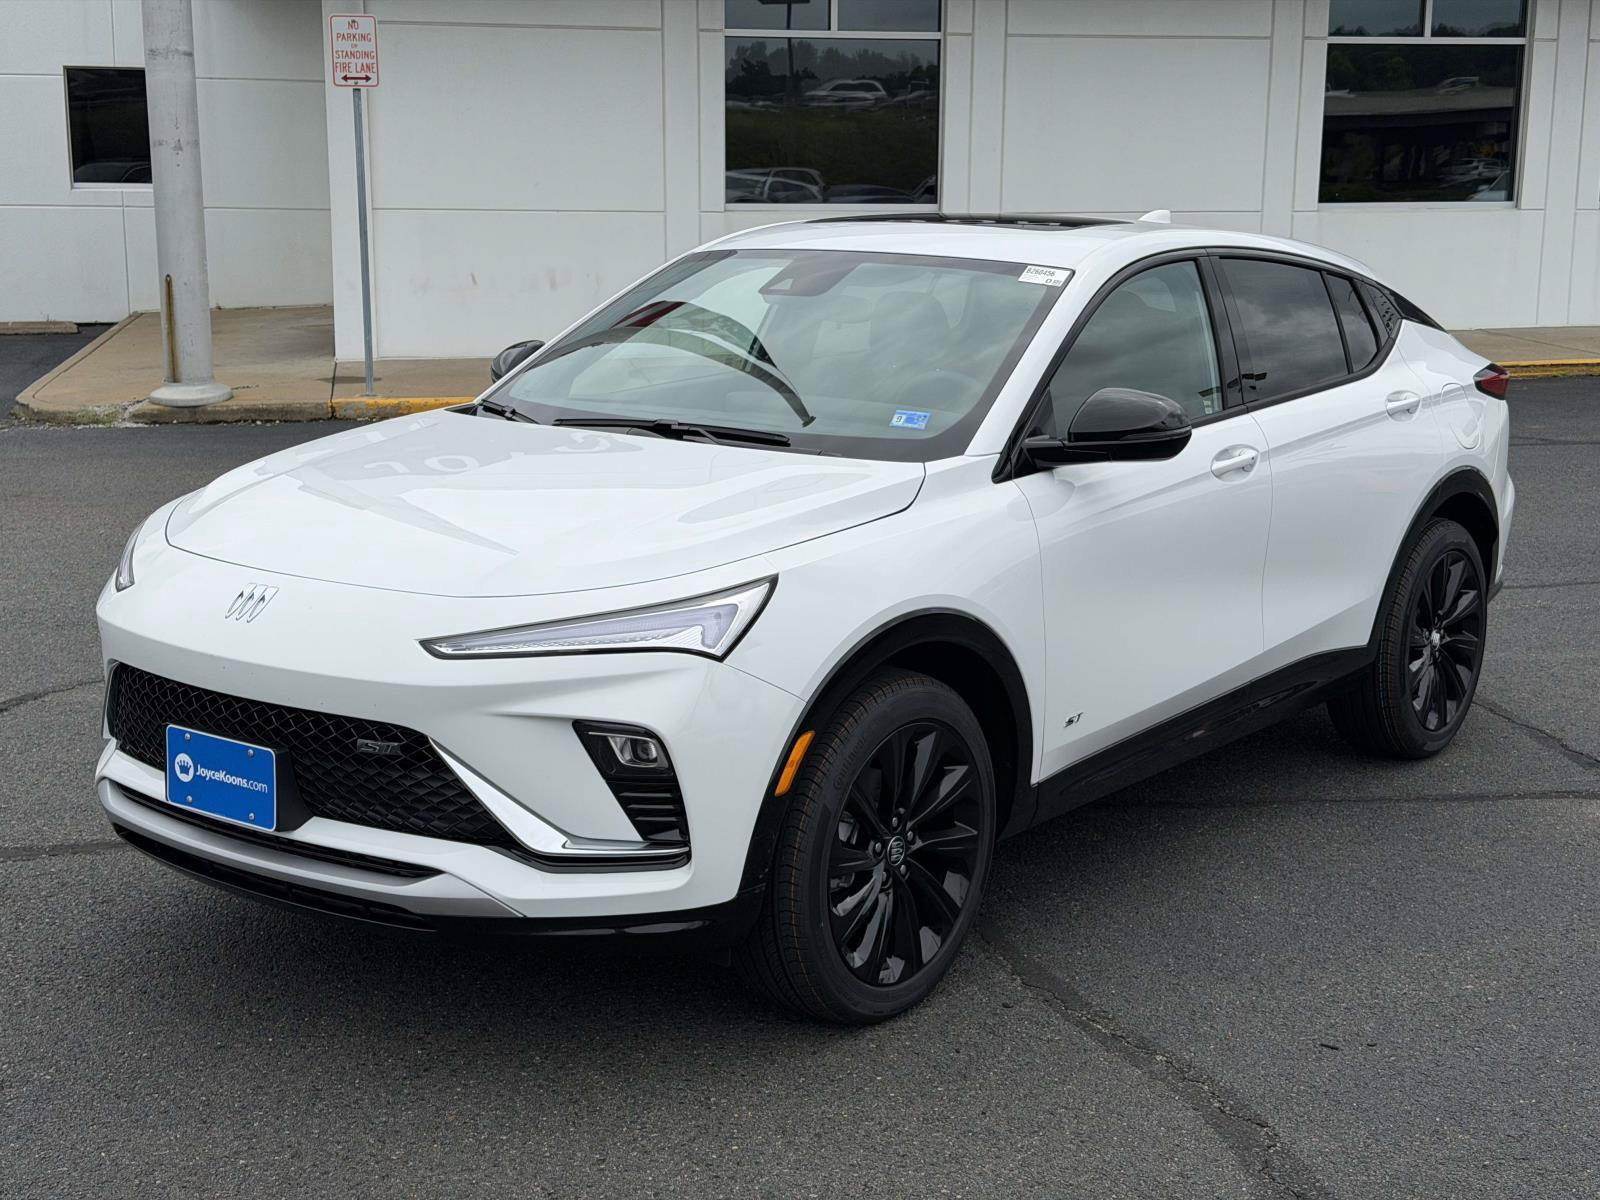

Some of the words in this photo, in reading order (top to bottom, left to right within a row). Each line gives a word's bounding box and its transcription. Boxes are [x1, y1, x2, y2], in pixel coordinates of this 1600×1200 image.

[347, 20, 359, 31] NO
[336, 32, 372, 42] PARKING
[335, 50, 375, 60] STANDING
[335, 61, 353, 74] FIRE
[354, 62, 376, 74] LANE
[195, 764, 269, 793] JoyceKoons.com
